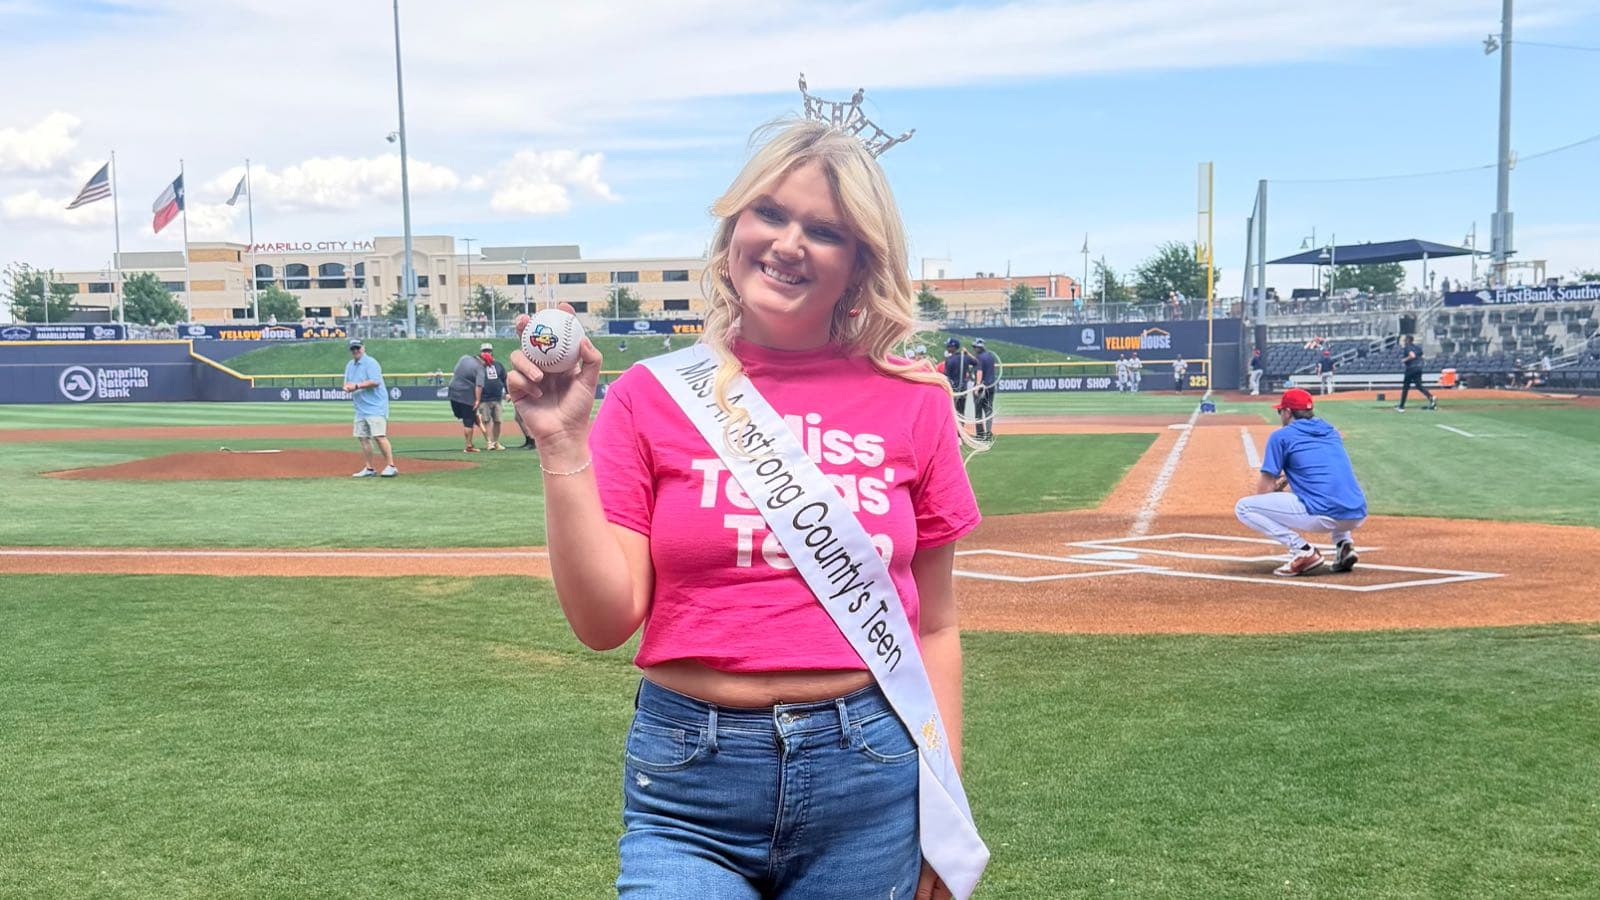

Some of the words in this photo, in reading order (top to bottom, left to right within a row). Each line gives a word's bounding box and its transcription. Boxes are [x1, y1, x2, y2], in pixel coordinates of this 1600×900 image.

[317, 242, 347, 251] CITY
[98, 367, 149, 378] Amarillo
[98, 376, 149, 388] National
[998, 378, 1028, 391] SONCY
[1032, 378, 1057, 390] ROAD
[1058, 378, 1082, 390] BODY
[1086, 377, 1111, 389] SHOP
[1189, 375, 1207, 387] 325
[98, 387, 130, 398] Bank
[298, 388, 321, 400] Hand
[691, 458, 895, 515] Teas'
[706, 394, 805, 509] Amstrong
[791, 501, 872, 613] County's
[861, 600, 903, 673] Teen
